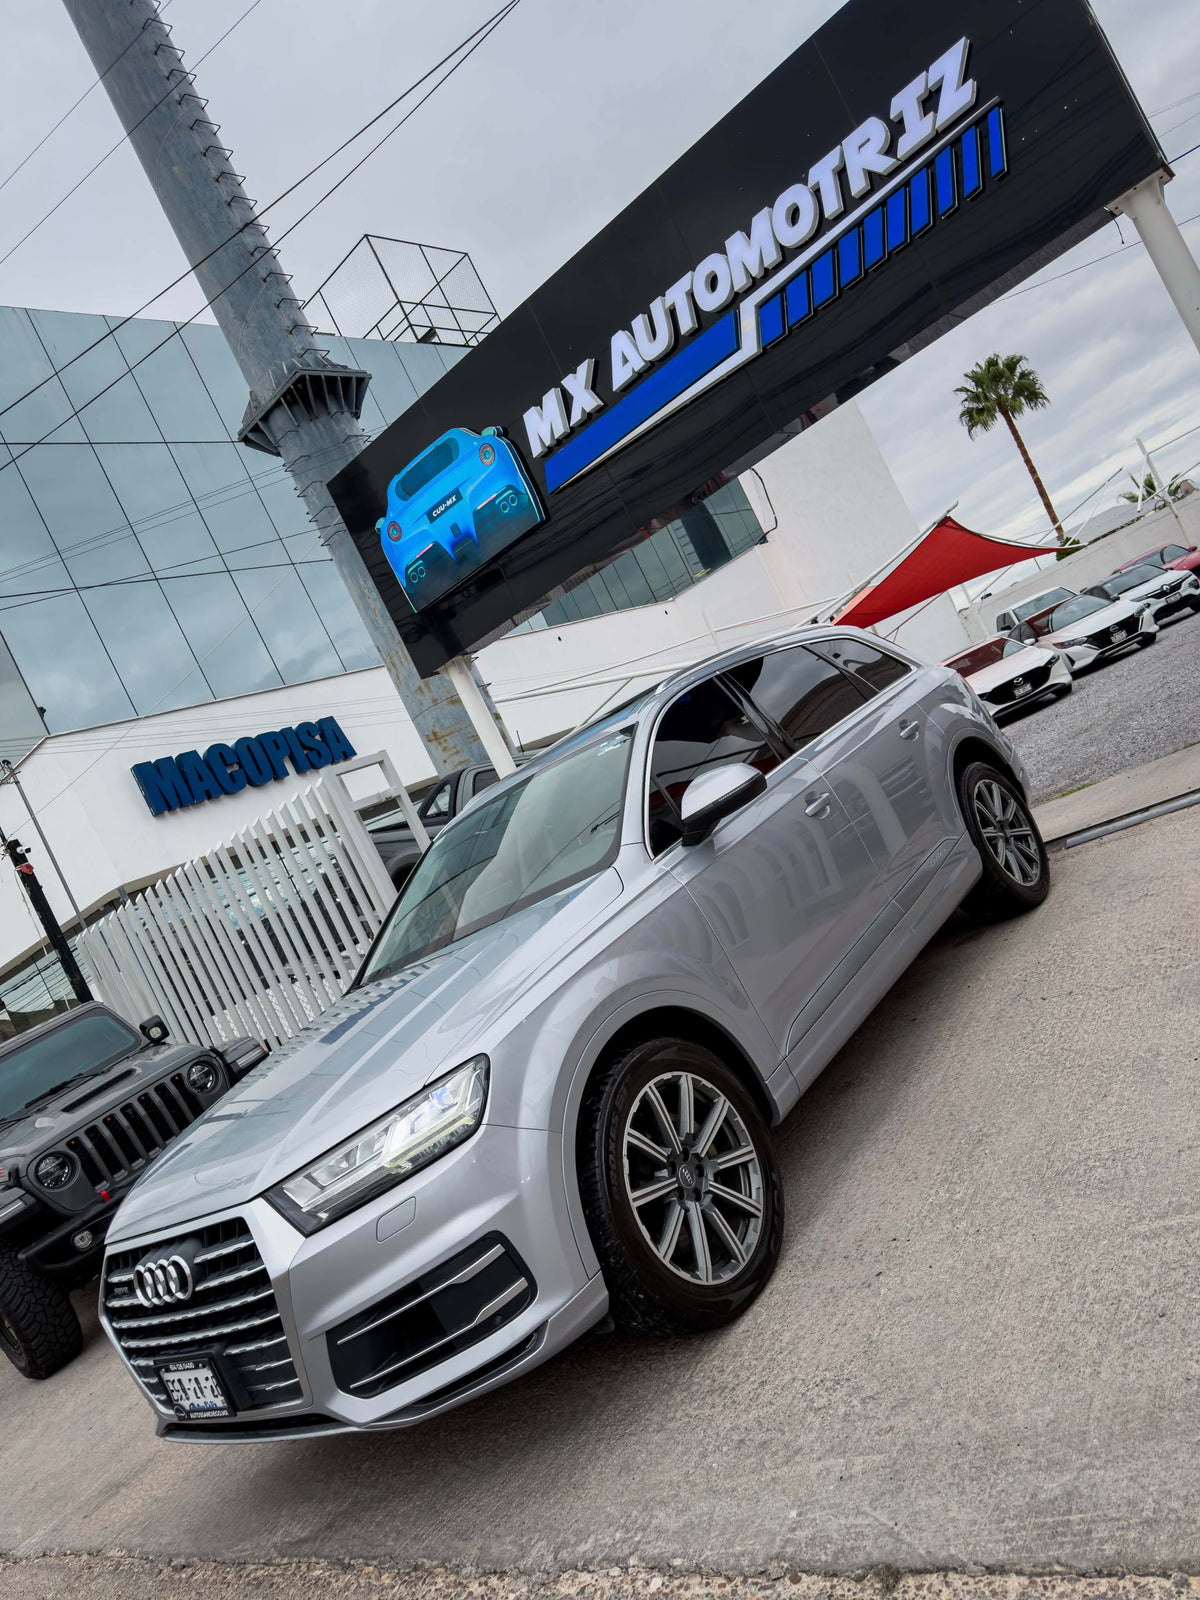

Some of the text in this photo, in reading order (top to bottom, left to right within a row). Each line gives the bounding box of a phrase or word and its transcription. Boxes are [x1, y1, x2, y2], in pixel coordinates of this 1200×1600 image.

[523, 36, 977, 458] MX AUTOMOTRIZ
[432, 494, 457, 517] CUU-MX
[130, 715, 358, 817] MACOPISA
